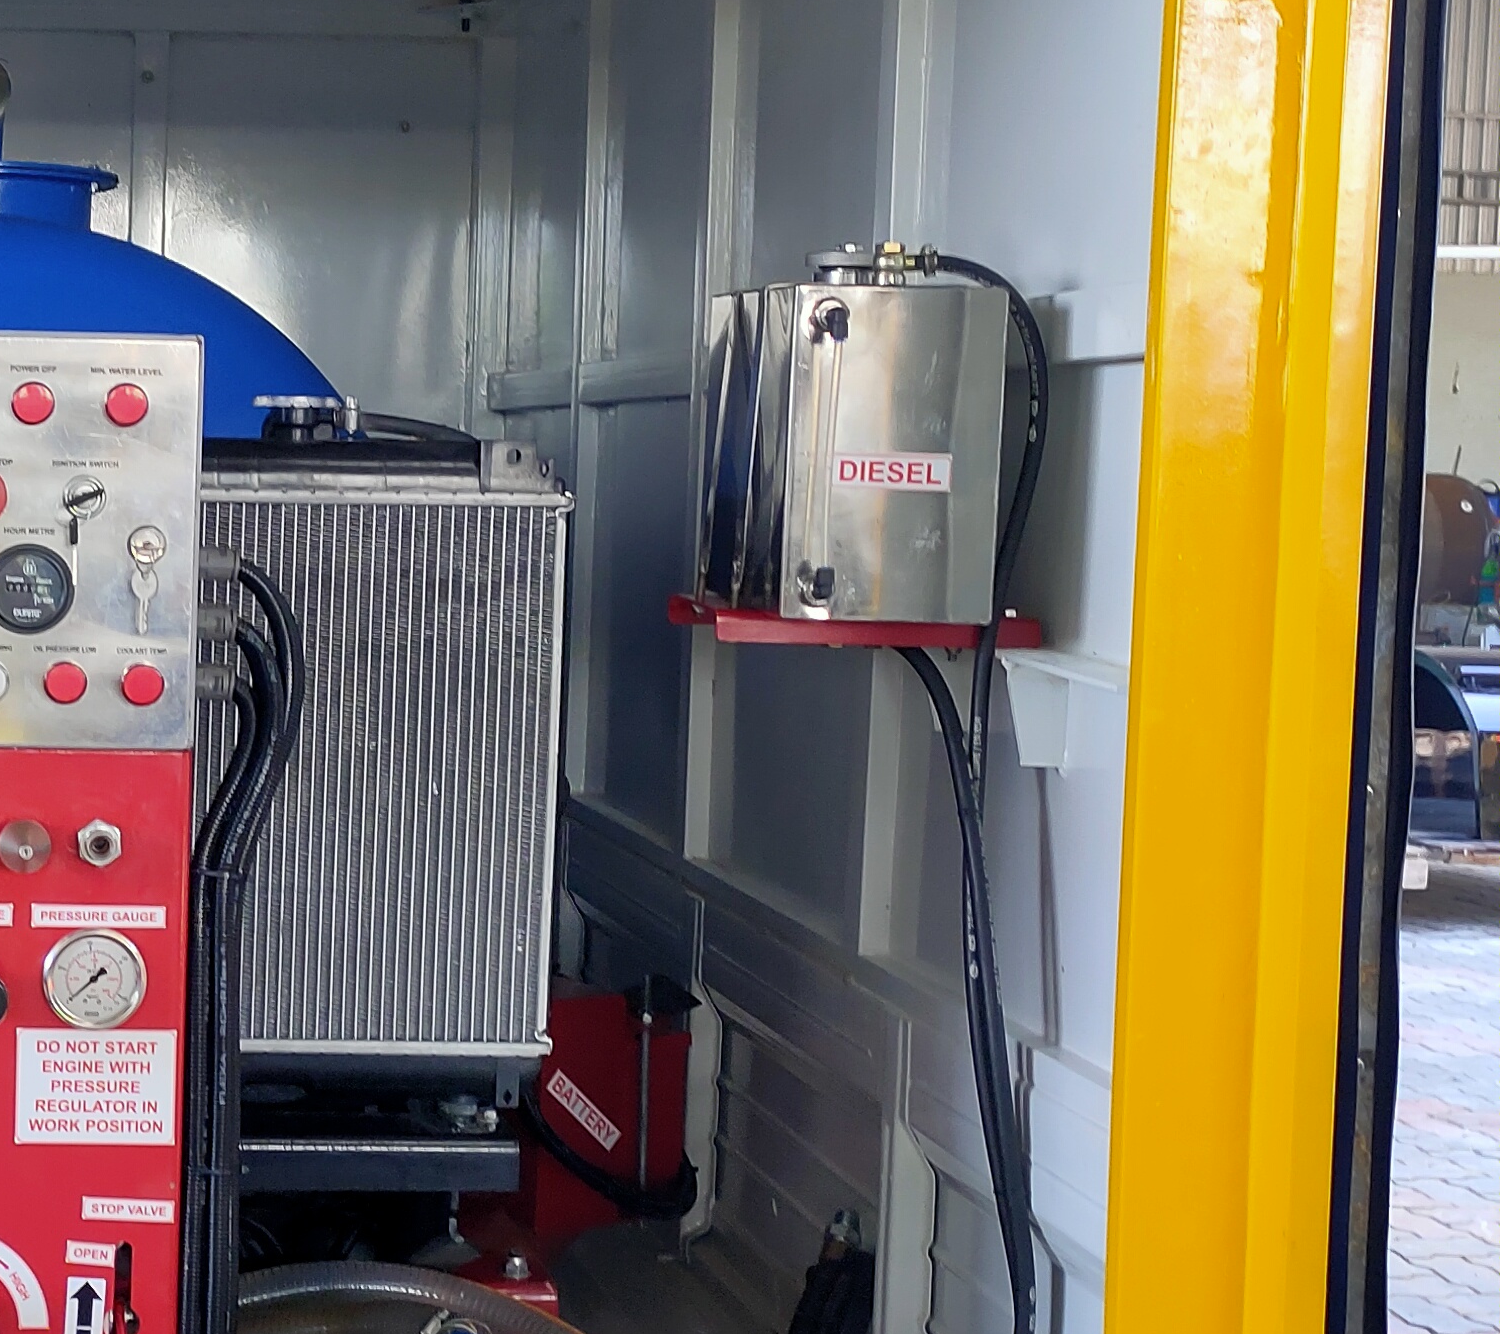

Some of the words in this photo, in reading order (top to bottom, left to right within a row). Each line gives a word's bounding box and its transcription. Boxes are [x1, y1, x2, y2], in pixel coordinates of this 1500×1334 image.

[109, 368, 137, 376] WATER
[139, 369, 163, 377] LEVEL
[839, 459, 942, 485] DIESEL
[40, 911, 108, 922] PRESSURE
[112, 911, 157, 923] GAUGE
[36, 1040, 61, 1053] DO
[66, 1041, 100, 1054] NOT
[105, 1041, 158, 1055] START
[42, 1060, 104, 1074] ENGINE
[109, 1061, 151, 1074] WITH
[51, 1080, 140, 1094] PRESSURE
[35, 1099, 137, 1113] REGULATOR
[142, 1101, 158, 1113] IN
[552, 1075, 615, 1141] BATTERY
[29, 1119, 80, 1132] WORK
[86, 1120, 163, 1133] POSITION
[91, 1203, 124, 1214] STOP
[128, 1205, 167, 1216] VALVE
[73, 1248, 108, 1260] OPEN
[9, 1271, 31, 1301] HIGH
